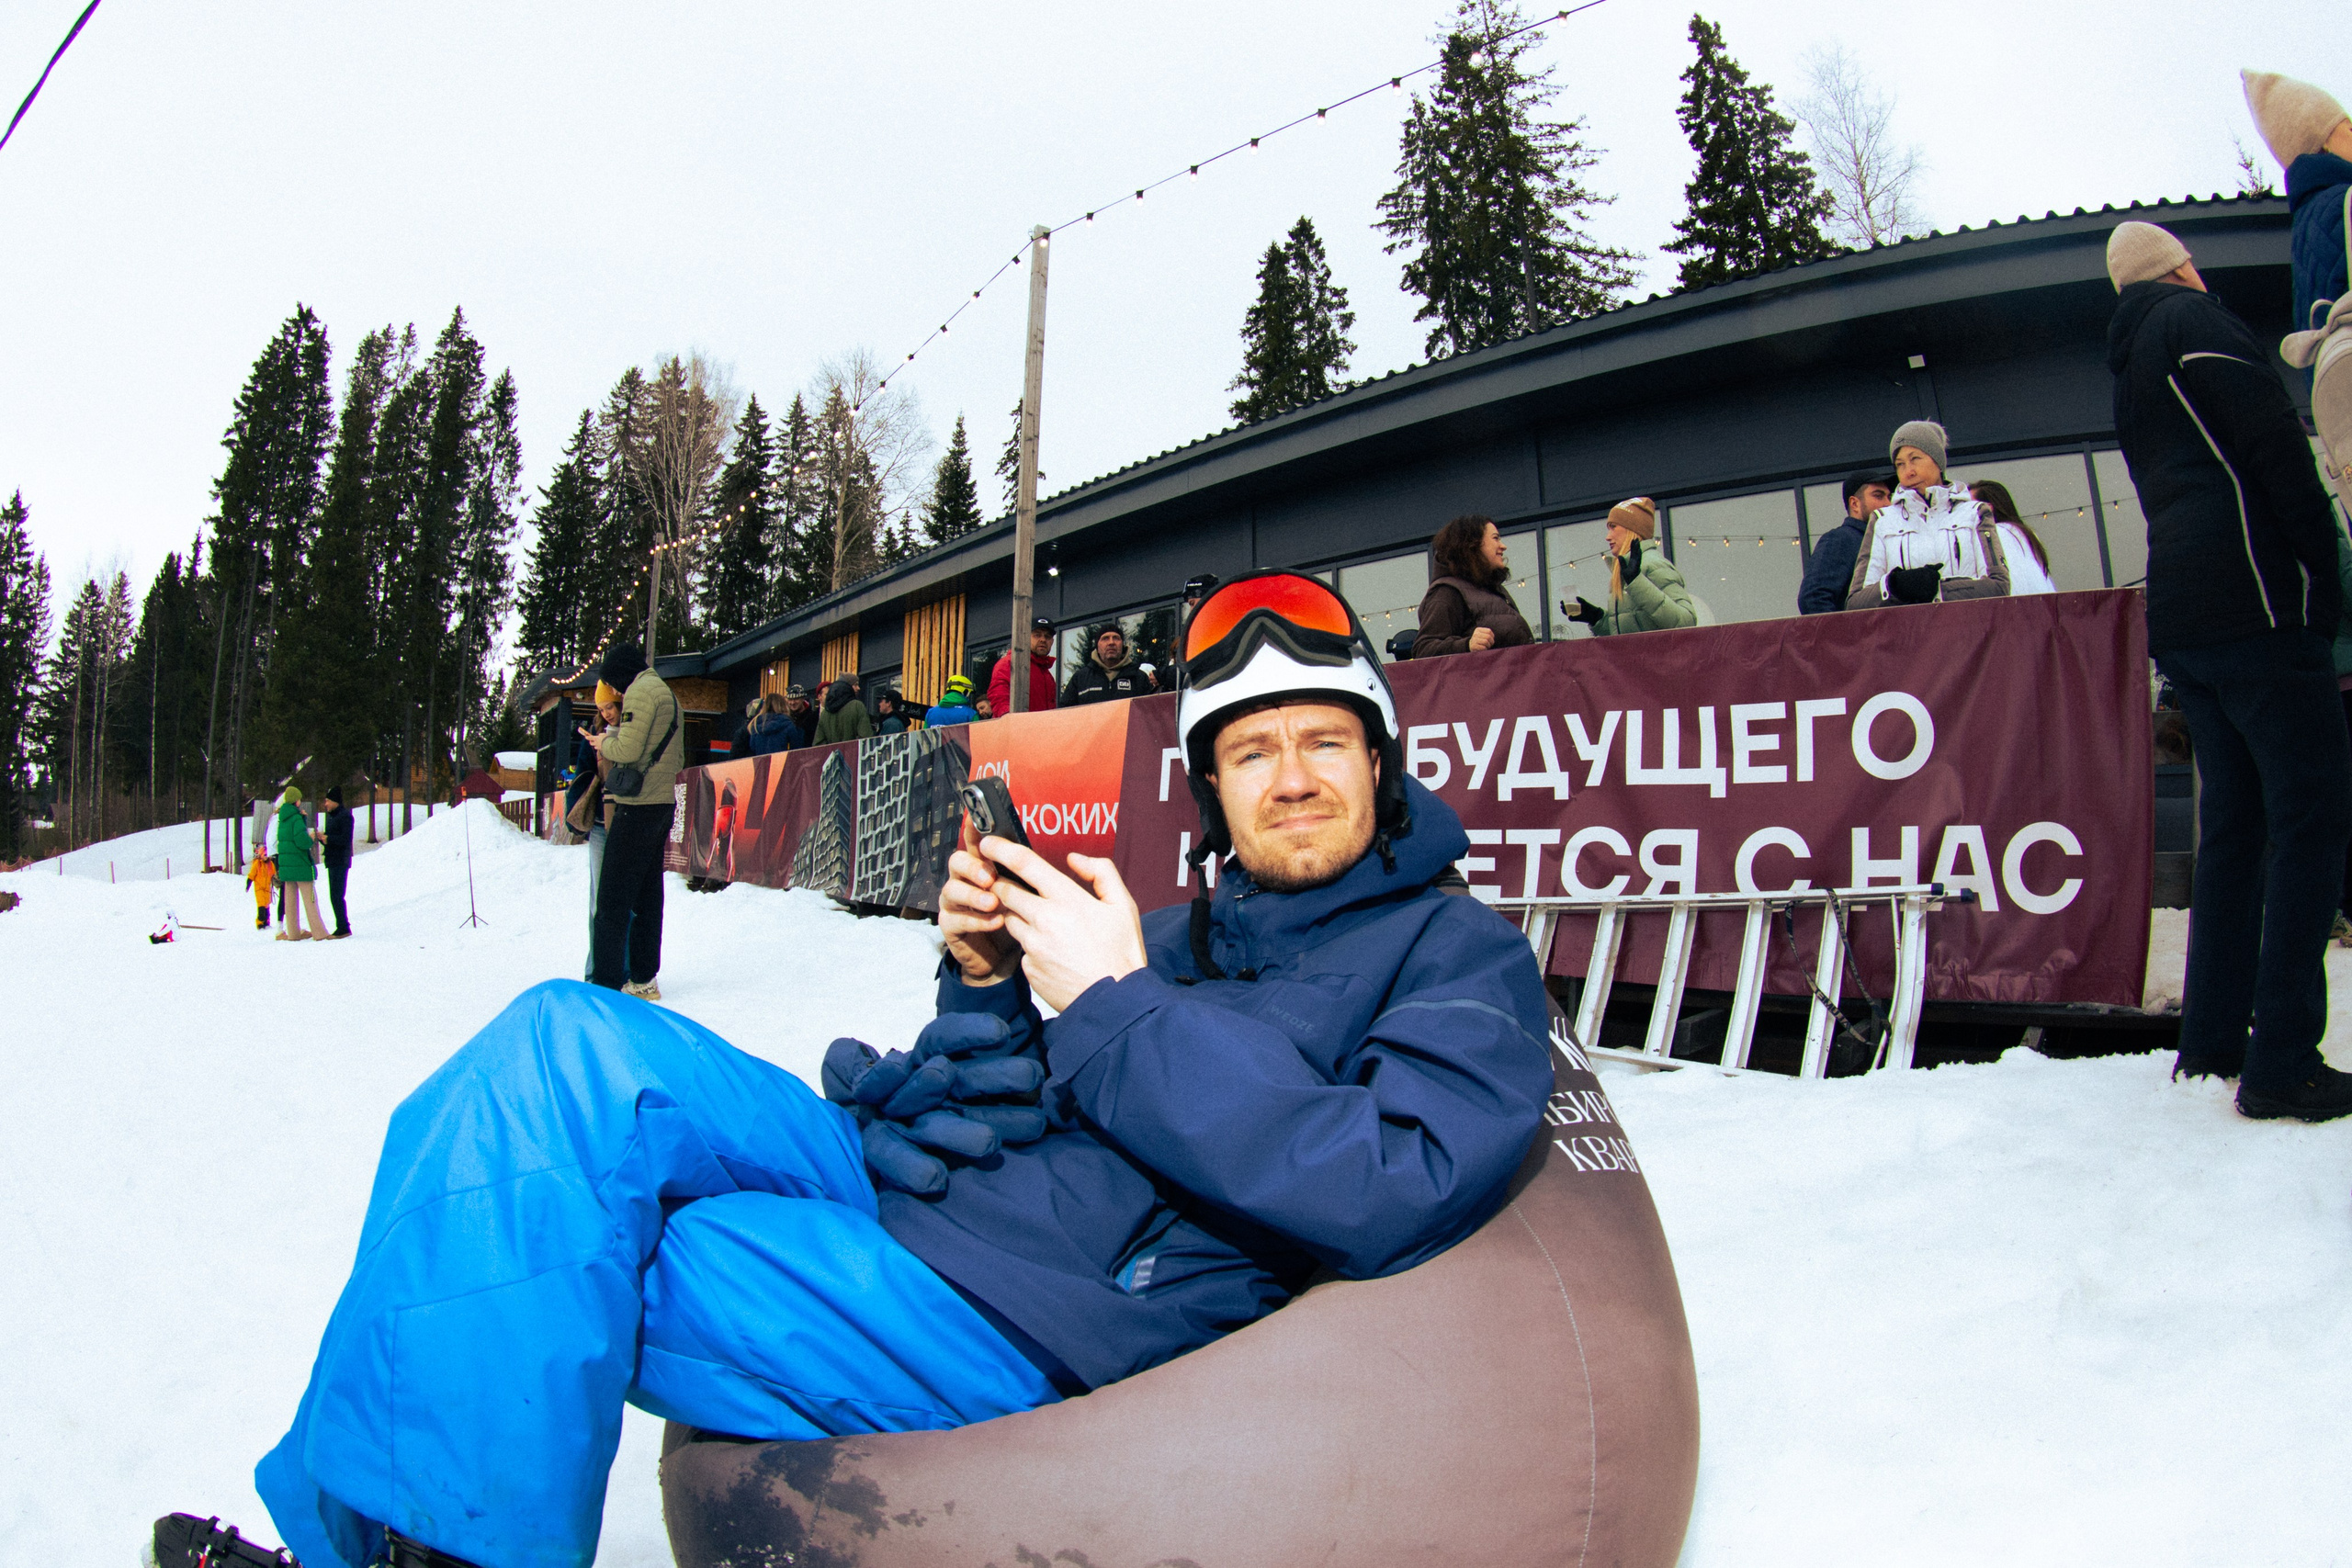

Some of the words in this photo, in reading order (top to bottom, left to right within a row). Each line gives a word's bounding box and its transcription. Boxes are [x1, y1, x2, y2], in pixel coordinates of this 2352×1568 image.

[1406, 691, 1935, 801] БУДУЩЕГО
[1015, 802, 1119, 836] КОКИХ
[1735, 826, 1812, 912] С
[1850, 821, 2084, 915] НАС
[1544, 1090, 1623, 1128] БИР
